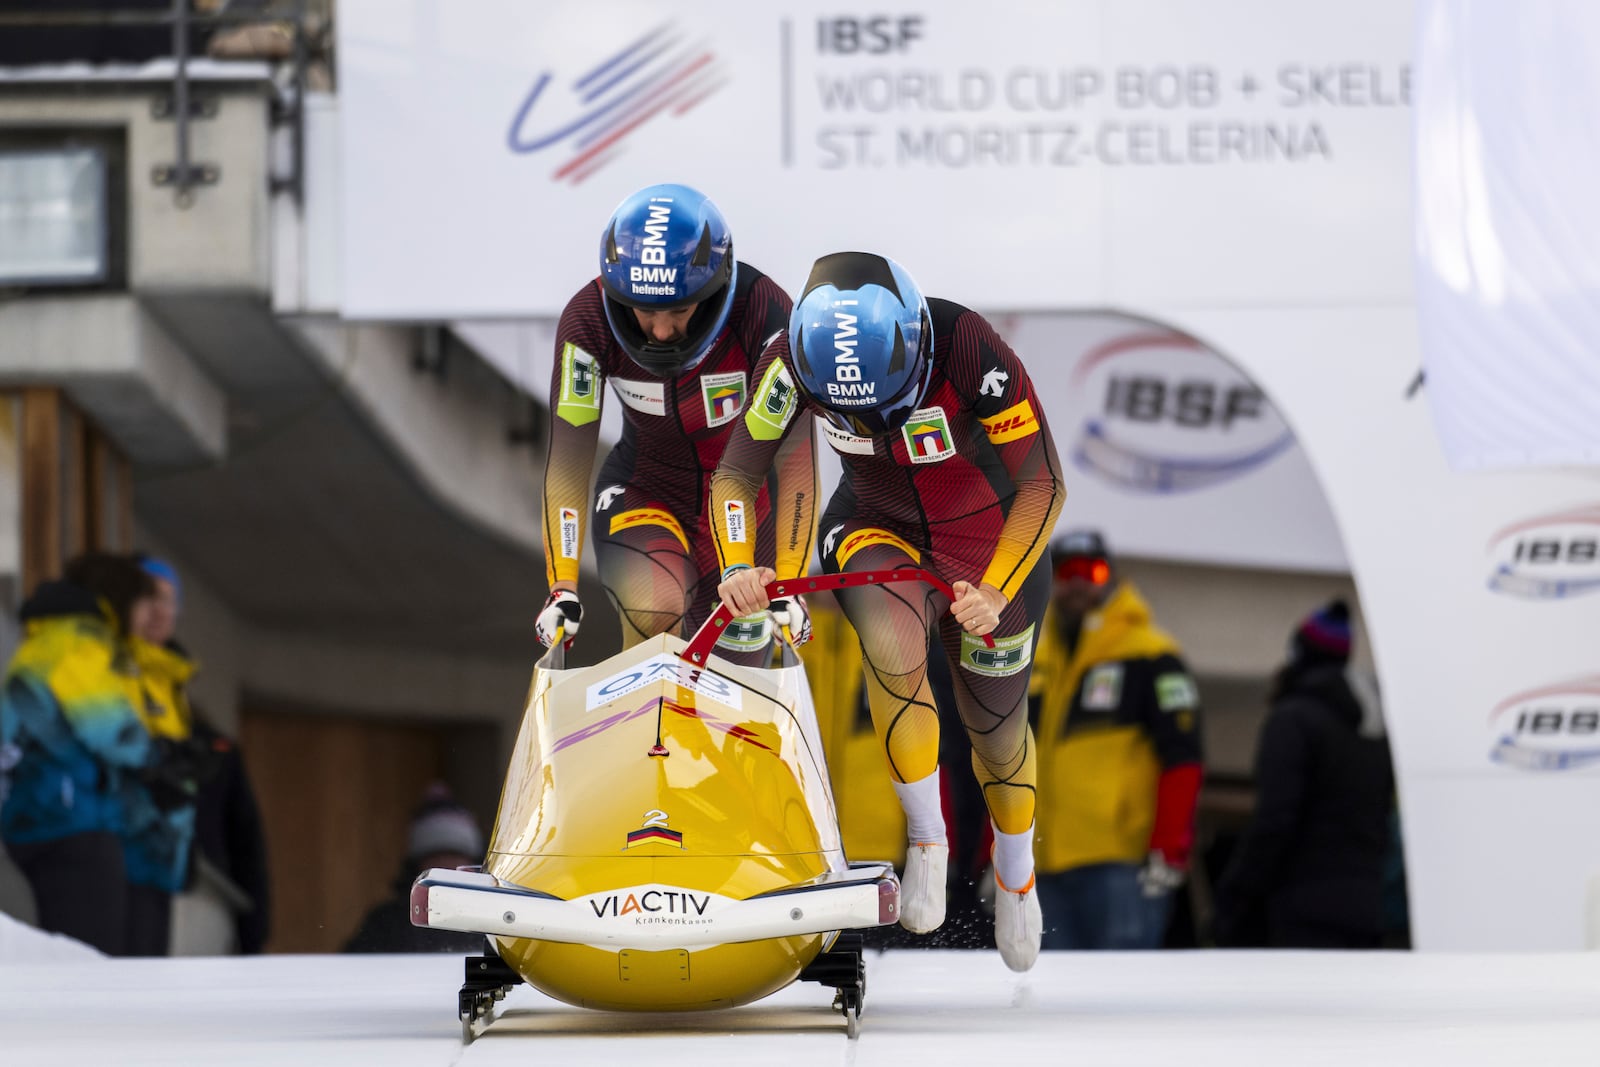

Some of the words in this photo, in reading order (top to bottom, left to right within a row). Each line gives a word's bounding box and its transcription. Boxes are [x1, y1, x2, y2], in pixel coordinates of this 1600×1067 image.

[816, 15, 925, 55] IBSF
[816, 68, 994, 112] WORLD
[1005, 66, 1103, 111] CUP
[1115, 64, 1220, 110] BOB
[815, 122, 884, 170] ST.
[896, 118, 1334, 168] MORITZ-CELERINA
[630, 266, 677, 282] BMW
[632, 284, 676, 296] helmets
[827, 382, 875, 396] BMW
[831, 396, 877, 406] helmets
[1104, 375, 1265, 432] IBSF
[983, 415, 1026, 435] DHL
[789, 492, 805, 551] Bundeswehr
[642, 809, 669, 827] 2
[590, 891, 710, 918] VIACTIV
